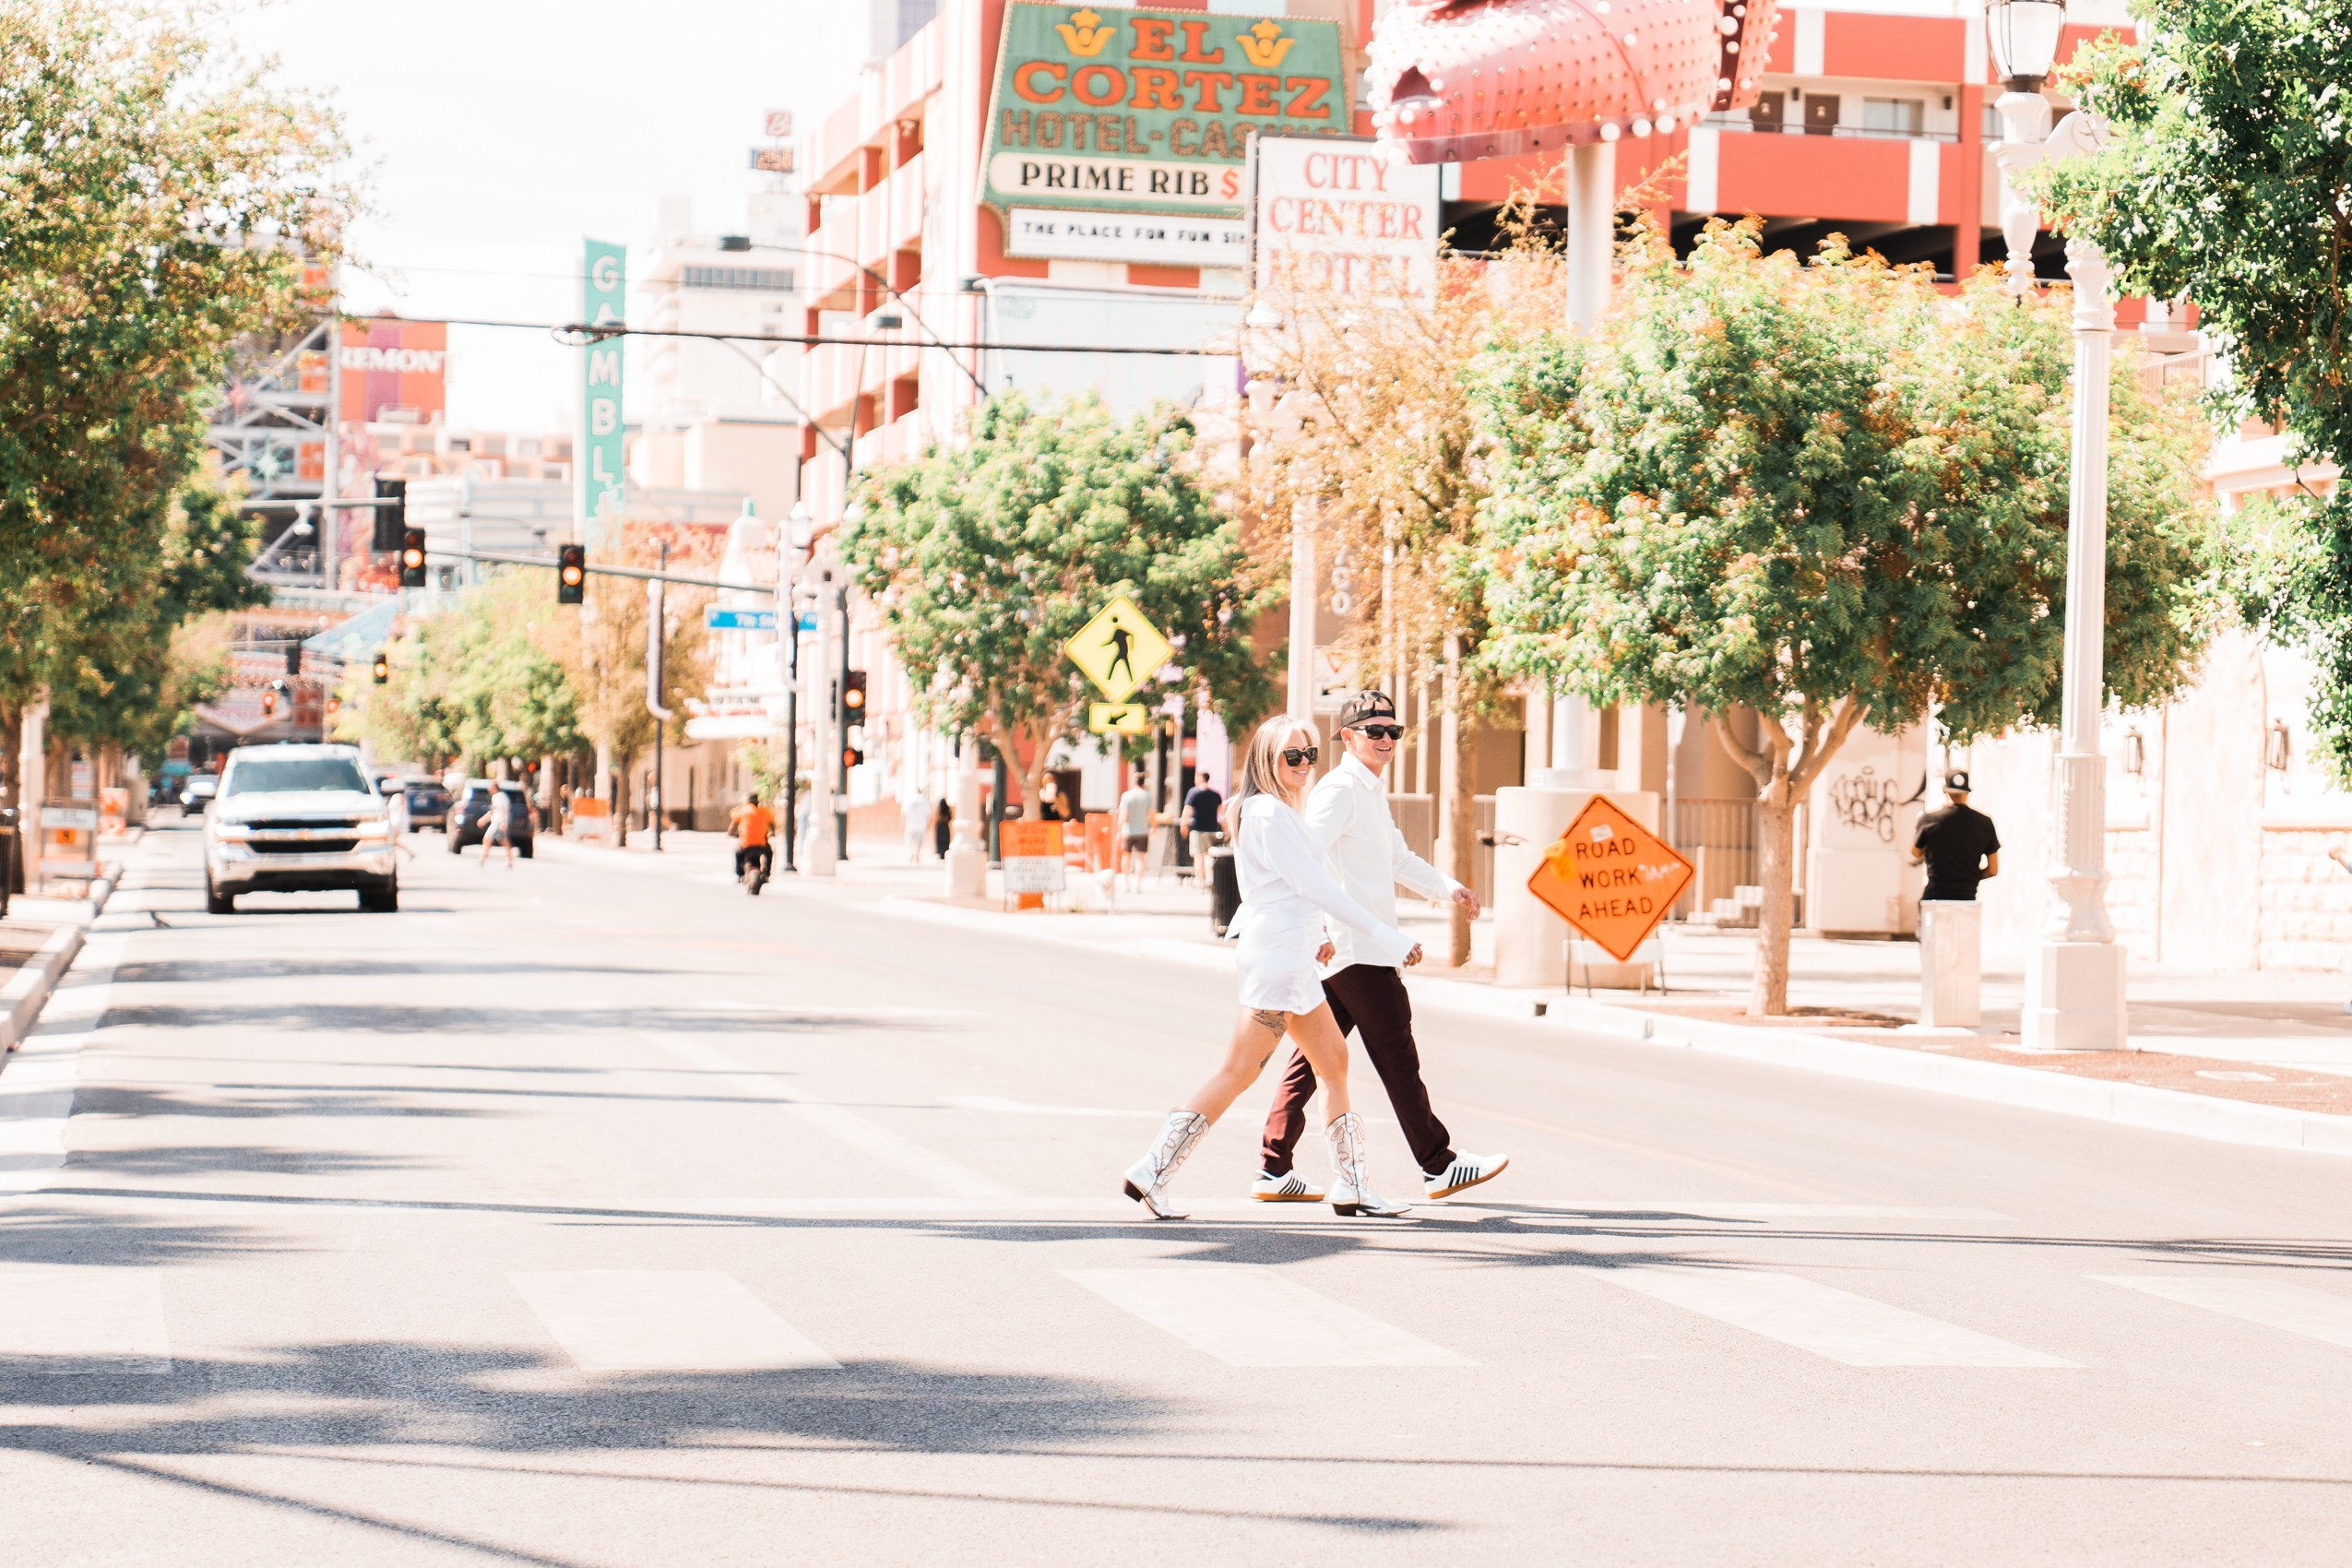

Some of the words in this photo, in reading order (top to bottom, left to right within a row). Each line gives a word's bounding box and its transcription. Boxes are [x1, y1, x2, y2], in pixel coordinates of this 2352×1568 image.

[1129, 18, 1225, 65] EL
[1014, 61, 1331, 119] CORTEZ
[1020, 162, 1134, 192] PRIME
[1150, 169, 1209, 196] RIB
[1220, 168, 1239, 200] $
[1304, 151, 1389, 191] CITY
[1024, 221, 1054, 234] THE
[1068, 222, 1122, 238] PLACE
[1134, 228, 1167, 241] FOR
[1179, 231, 1211, 243] FUN
[1268, 196, 1423, 240] CENTER
[1575, 837, 1636, 860] ROAD
[1579, 867, 1642, 888] WORK
[1579, 897, 1654, 920] AHEAD
